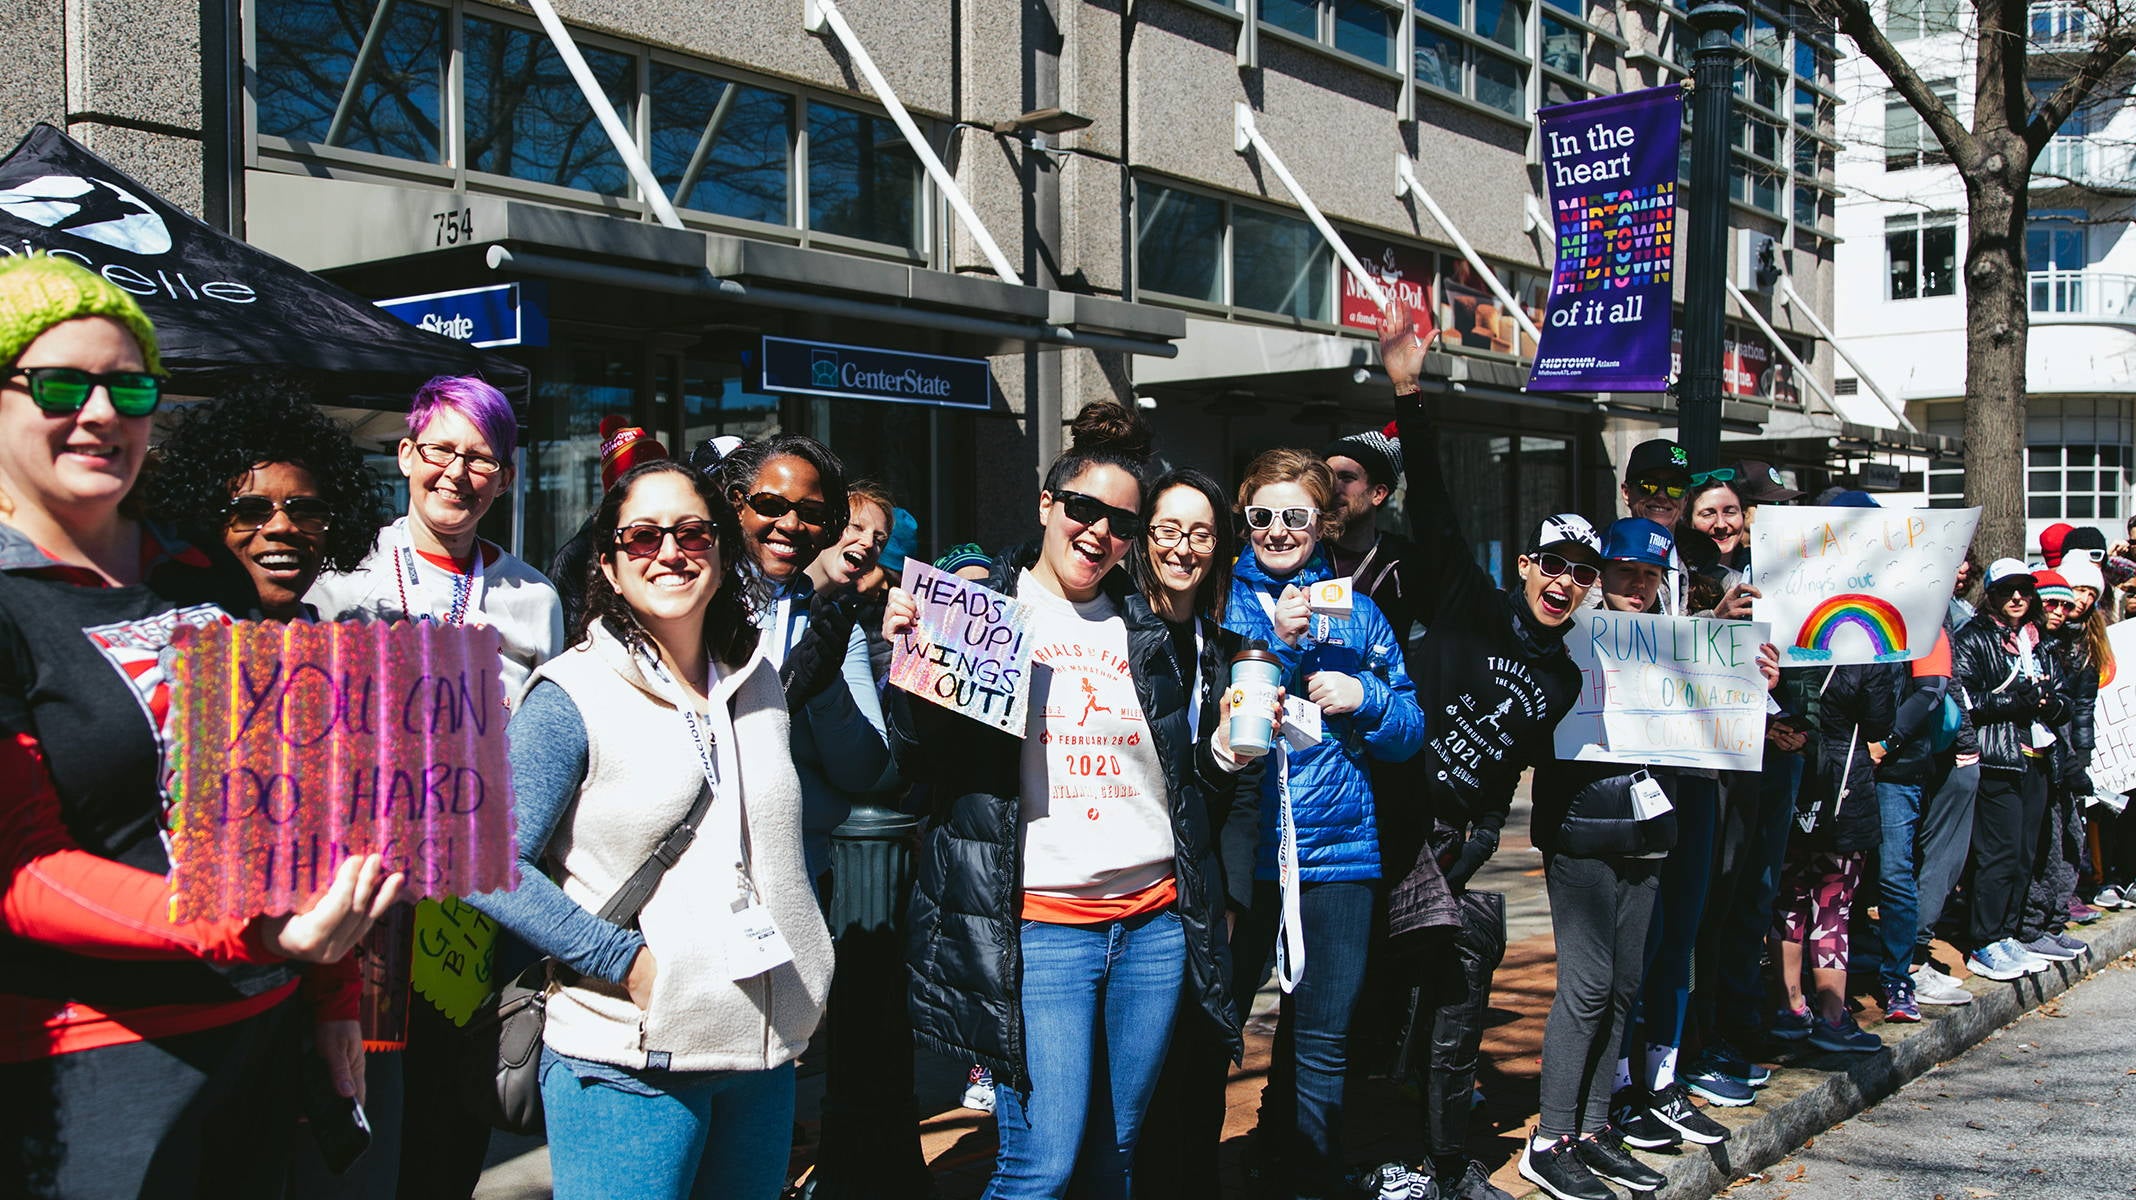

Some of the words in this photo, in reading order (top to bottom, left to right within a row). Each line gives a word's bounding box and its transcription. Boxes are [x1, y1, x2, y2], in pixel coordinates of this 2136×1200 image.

[1549, 131, 1581, 158] In
[1586, 123, 1635, 152] the
[1552, 151, 1631, 187] heart
[433, 207, 473, 247] 754
[1551, 301, 1582, 328] of
[1584, 299, 1604, 326] it
[1608, 295, 1643, 323] all
[841, 361, 951, 397] CenterState
[1540, 357, 1596, 369] MIDTOWN
[1596, 360, 1620, 368] Atlanta
[912, 573, 1007, 624] HEADS
[1847, 571, 1876, 590] out
[964, 620, 1024, 662] UP!
[1591, 616, 1658, 664] RUN
[1673, 618, 1753, 667] LIKE
[904, 633, 1021, 694] WINGS
[227, 661, 374, 750] YOU
[403, 669, 487, 737] CAN
[934, 672, 1016, 727] OUT!
[1495, 677, 1508, 687] THE
[1508, 682, 1533, 718] MARATHON
[1579, 669, 1623, 707] THE
[1059, 735, 1108, 745] FEBRUARY
[1112, 736, 1124, 745] 29
[1445, 730, 1482, 770] 2020
[1455, 716, 1488, 748] FEBRUARY
[1066, 754, 1121, 776] 2020
[218, 766, 301, 826] DO
[350, 762, 485, 825] HARD
[1279, 800, 1288, 862] TENACIOUS
[1280, 863, 1288, 885] TEN
